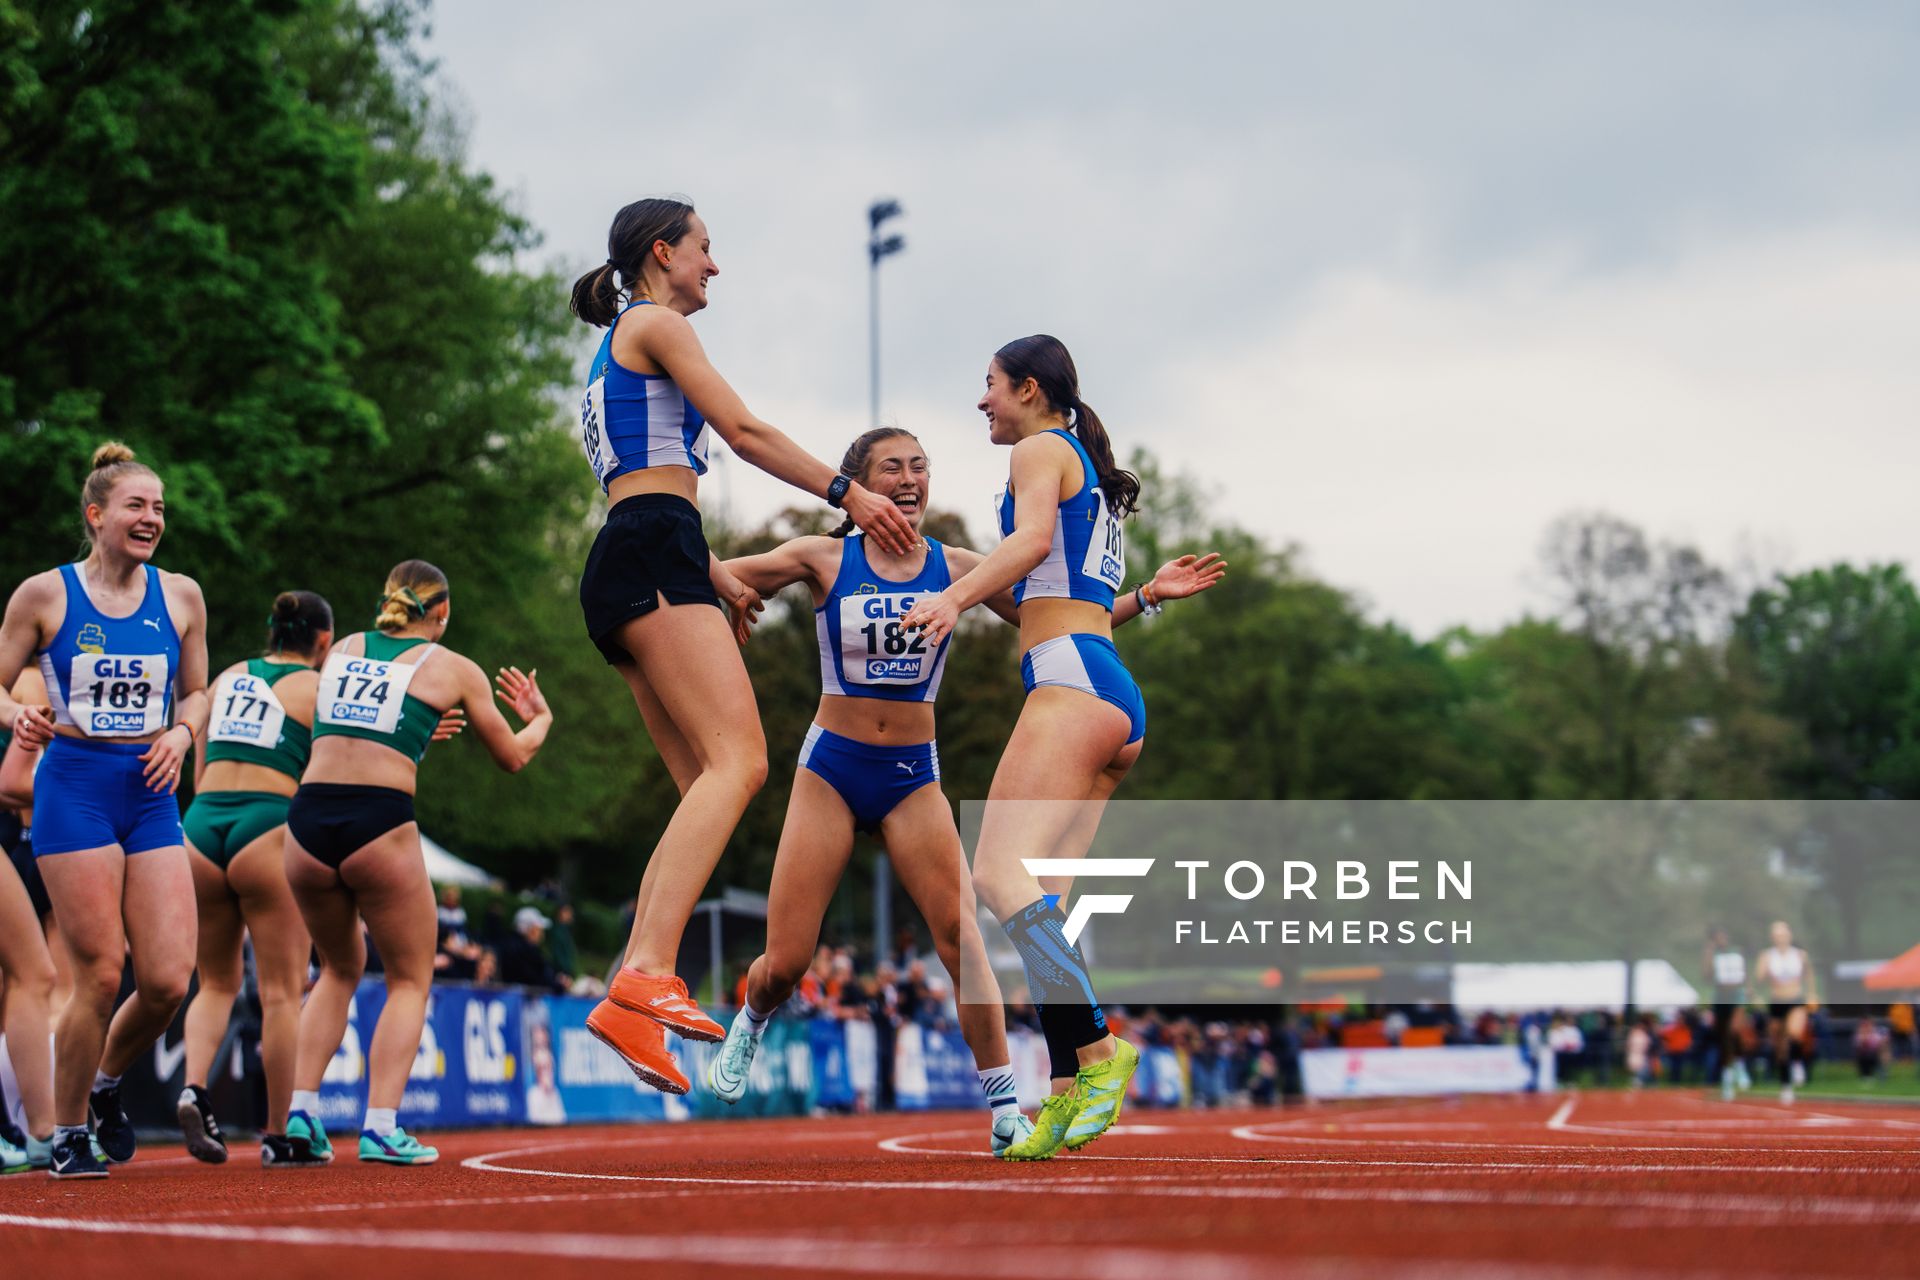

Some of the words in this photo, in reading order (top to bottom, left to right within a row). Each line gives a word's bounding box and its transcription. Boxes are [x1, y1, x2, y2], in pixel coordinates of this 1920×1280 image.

[583, 412, 600, 462] 185
[1105, 516, 1121, 561] 181
[860, 622, 927, 655] 182
[889, 661, 920, 672] PLAN
[89, 681, 151, 709] 183
[233, 678, 256, 693] GL
[337, 675, 390, 705] 174
[114, 715, 143, 725] PLAN
[225, 694, 269, 721] 171
